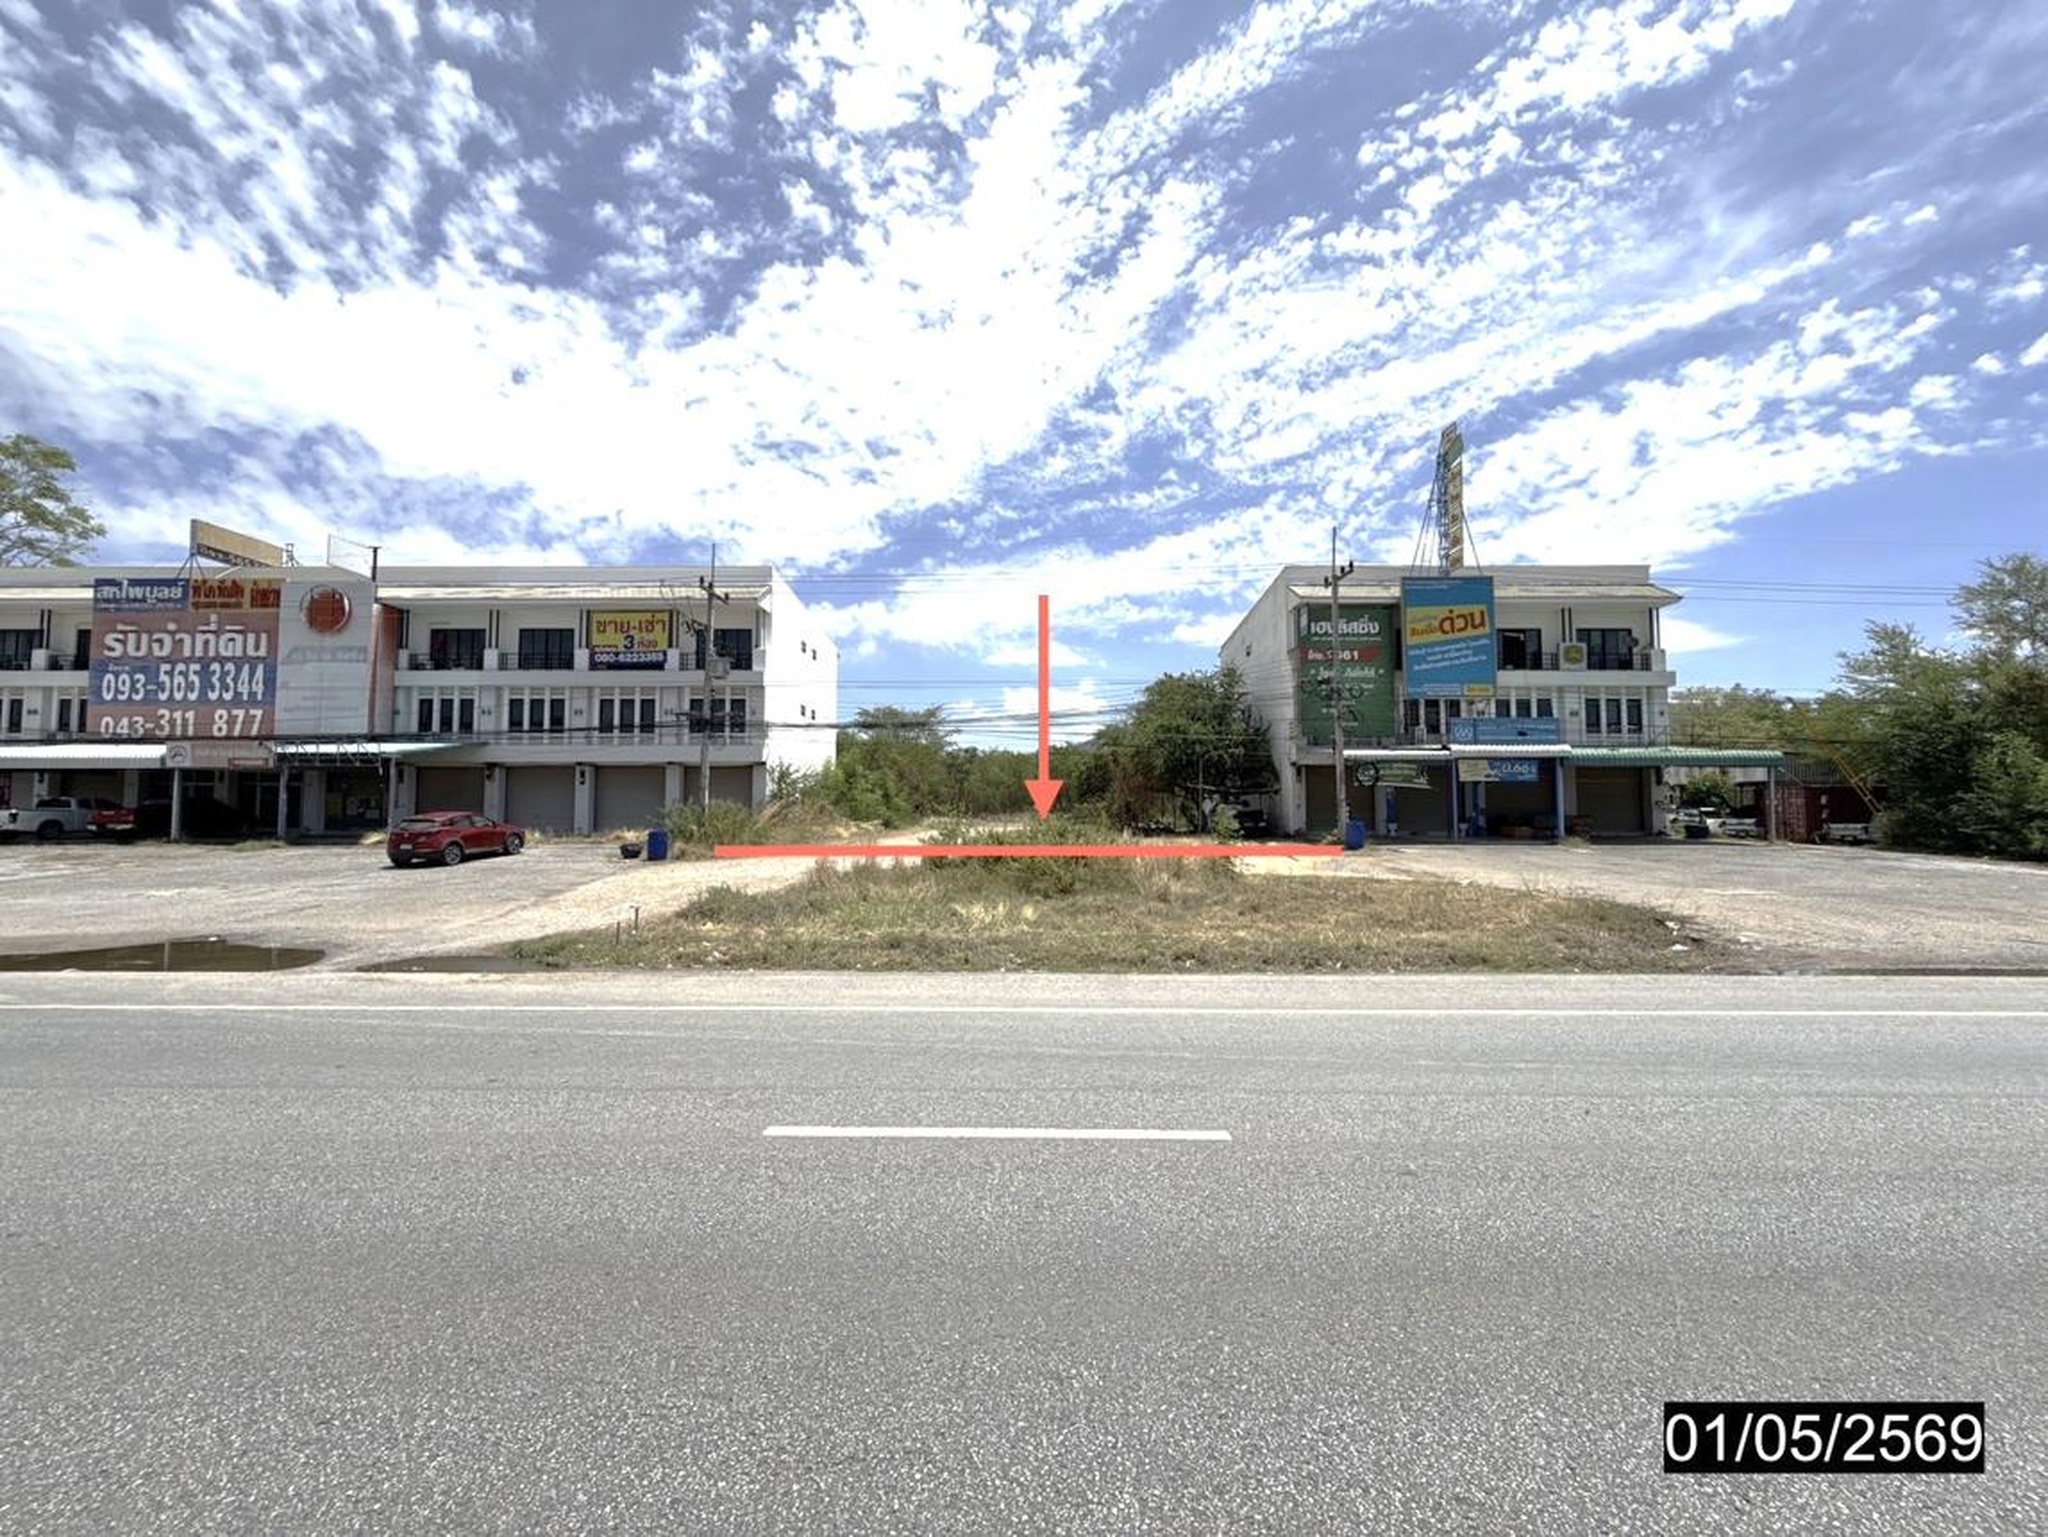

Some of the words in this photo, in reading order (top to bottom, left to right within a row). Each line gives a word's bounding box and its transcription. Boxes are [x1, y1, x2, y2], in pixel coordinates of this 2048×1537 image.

[96, 579, 184, 603] สหไพบูลย์
[595, 614, 667, 634] ขาย-เช่า
[1438, 608, 1487, 635] ด่วน
[103, 613, 268, 658] รับจำที่ดิน
[623, 634, 635, 650] 3
[102, 662, 200, 701] 093-565
[207, 662, 265, 701] 3344
[100, 708, 196, 738] 043-311
[212, 708, 264, 738] 877
